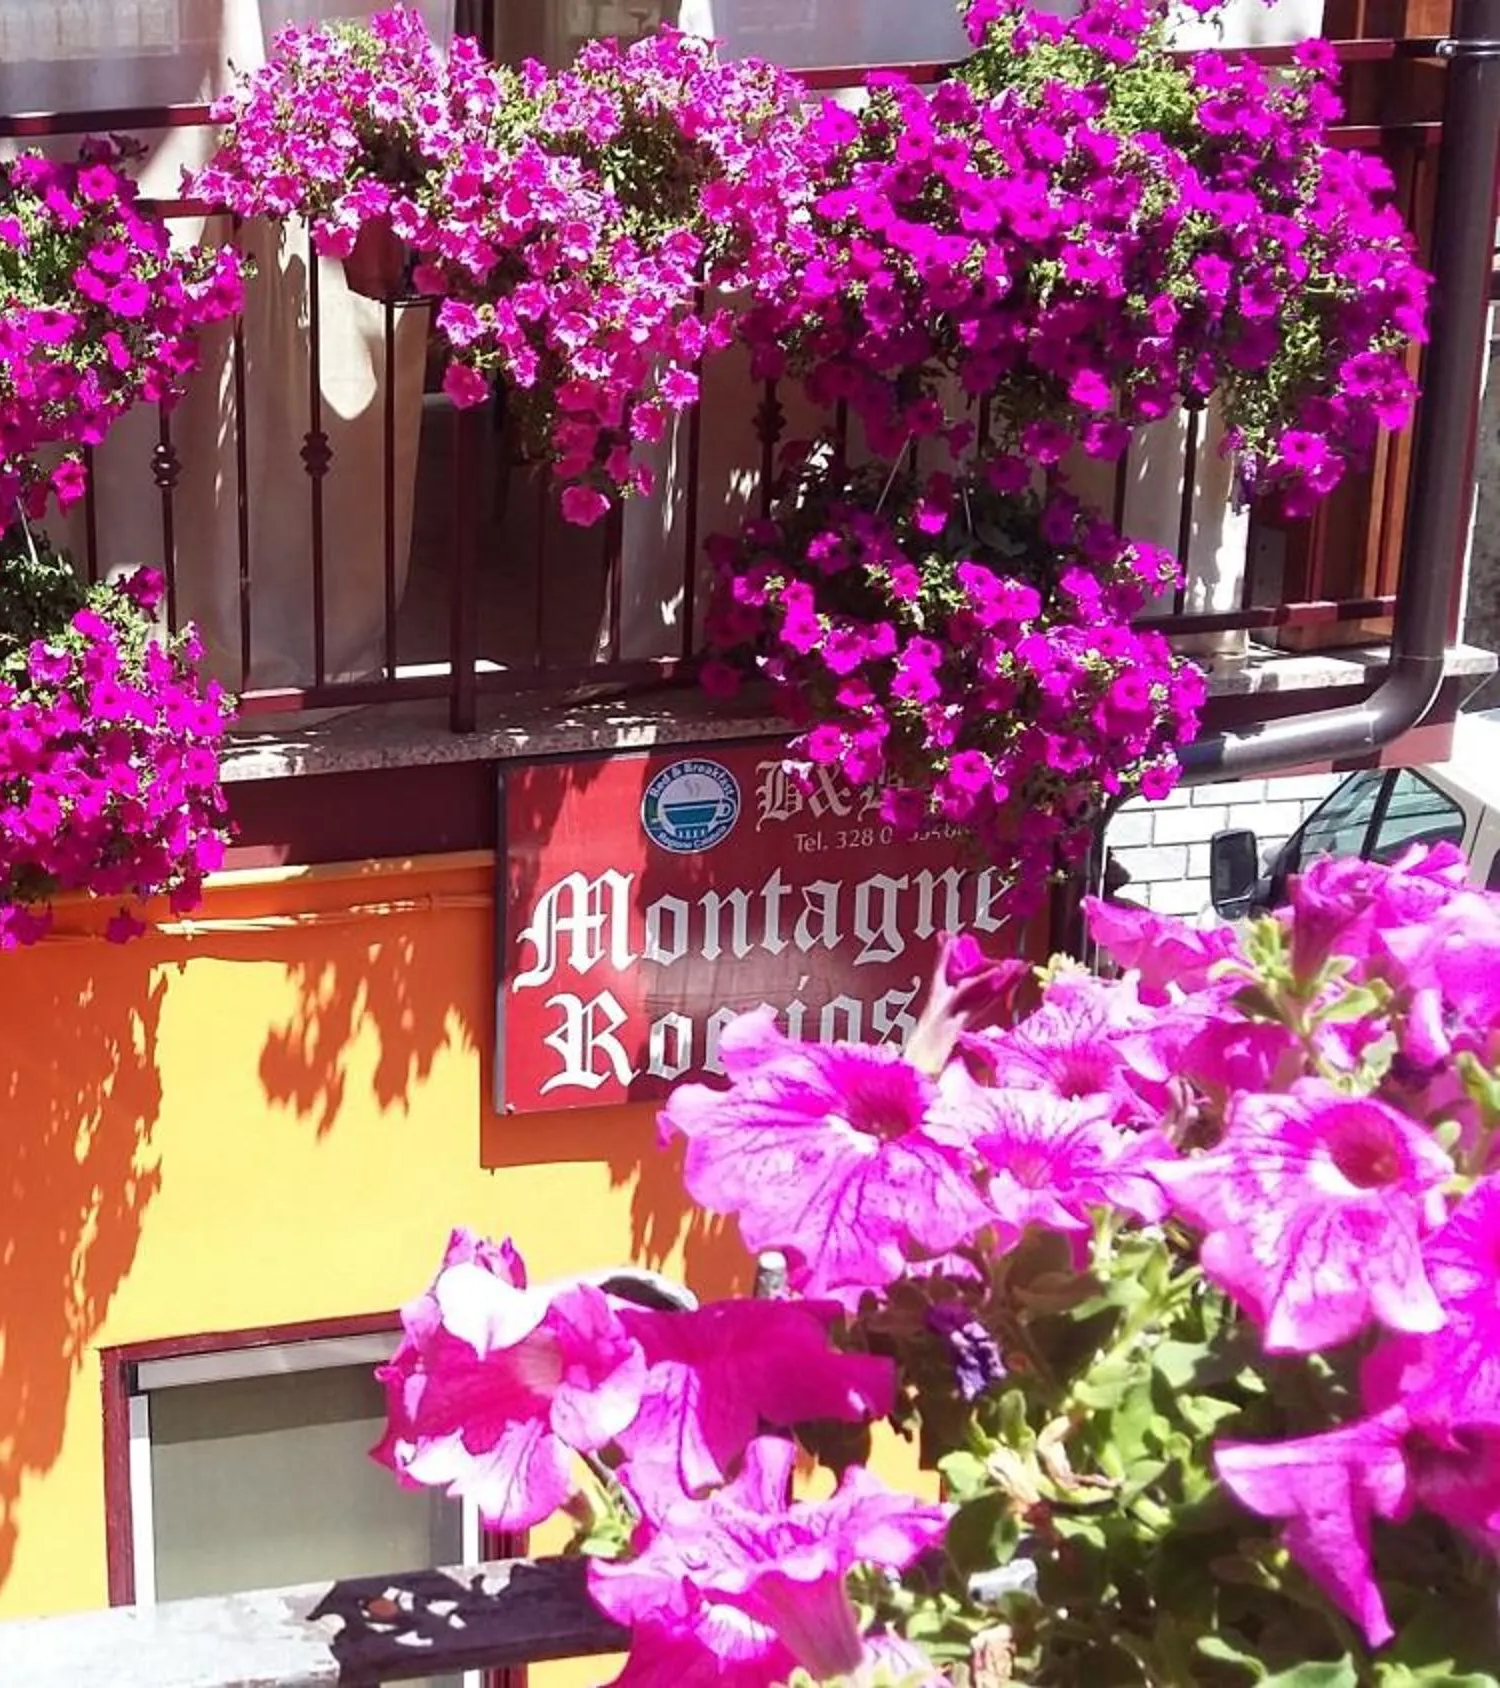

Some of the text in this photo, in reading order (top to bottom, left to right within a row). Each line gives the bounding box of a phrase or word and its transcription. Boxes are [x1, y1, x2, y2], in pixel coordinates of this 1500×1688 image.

[793, 831, 829, 852] Tel.
[835, 829, 874, 850] 328
[512, 866, 1013, 993] Montagne
